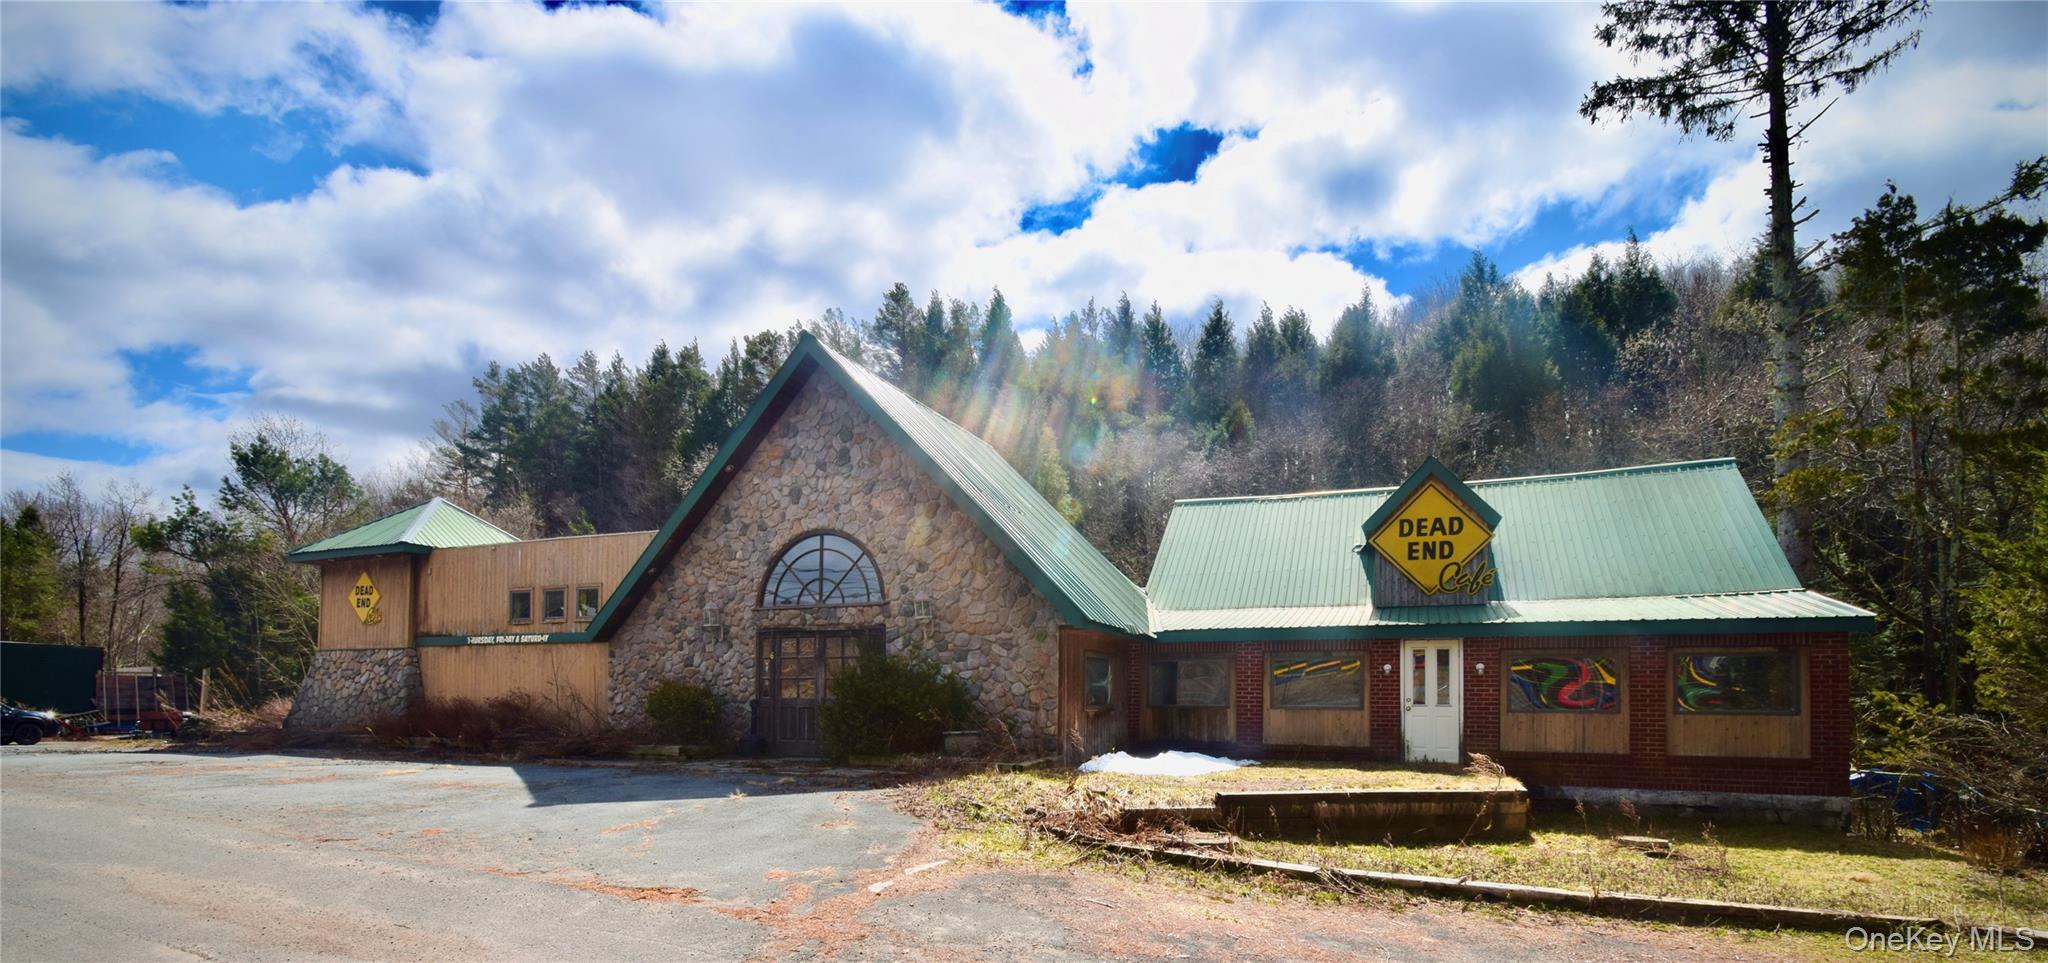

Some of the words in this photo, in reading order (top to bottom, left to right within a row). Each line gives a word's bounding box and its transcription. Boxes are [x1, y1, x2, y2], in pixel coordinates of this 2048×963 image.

[1399, 516, 1464, 537] DEAD
[1408, 541, 1454, 560] END
[1439, 561, 1497, 594] Café
[355, 585, 373, 595] DEAD
[356, 598, 371, 608] END
